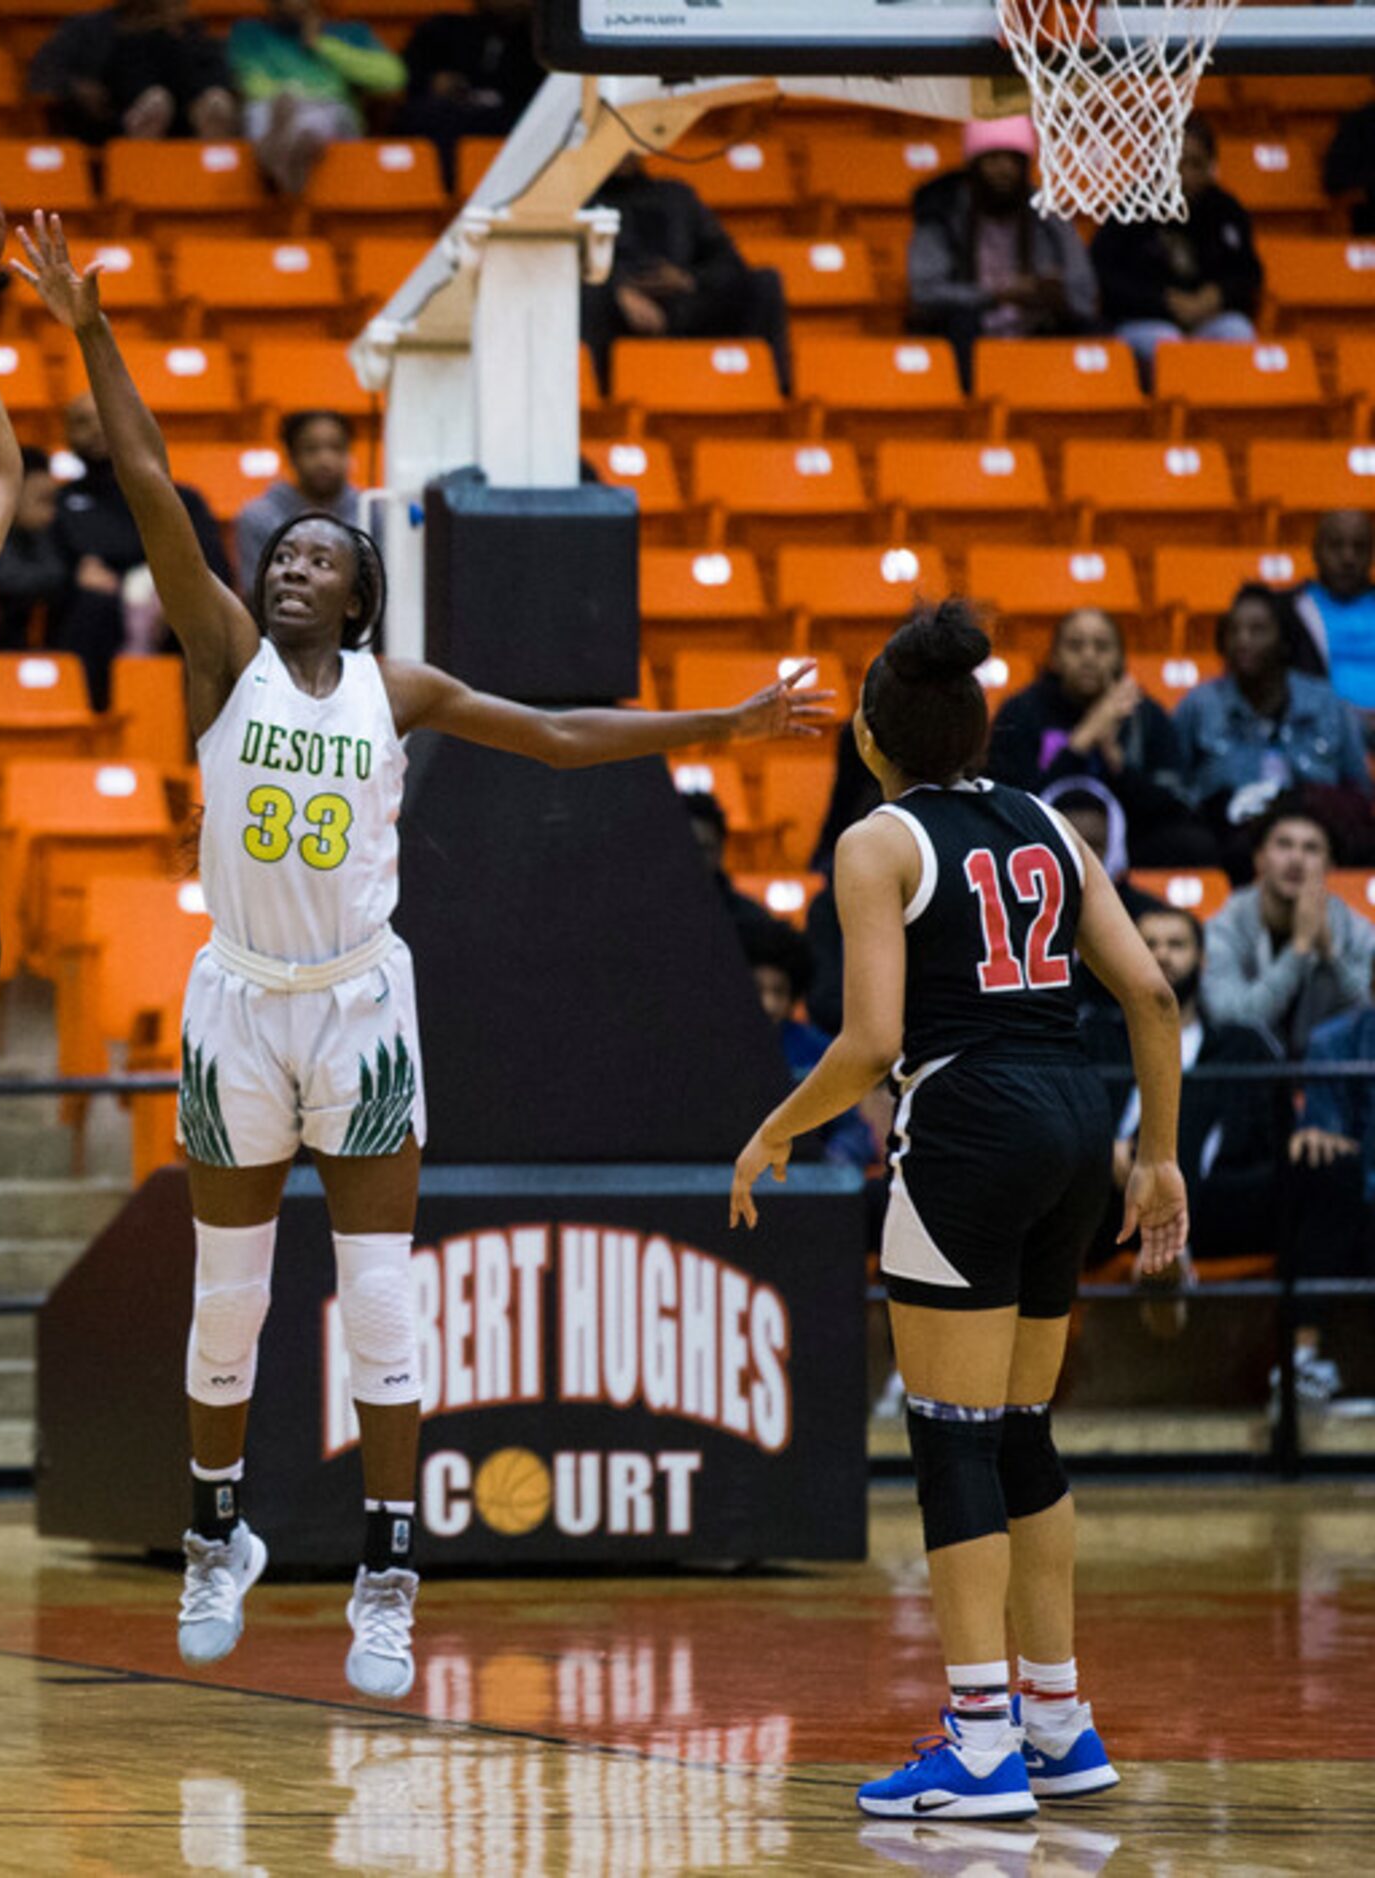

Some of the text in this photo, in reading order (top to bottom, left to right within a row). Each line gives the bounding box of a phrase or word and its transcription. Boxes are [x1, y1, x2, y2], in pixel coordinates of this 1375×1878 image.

[239, 720, 372, 781] DESOTO
[242, 784, 354, 871] 33
[963, 843, 1071, 992] 12
[322, 1222, 792, 1462] BERT HUGHES
